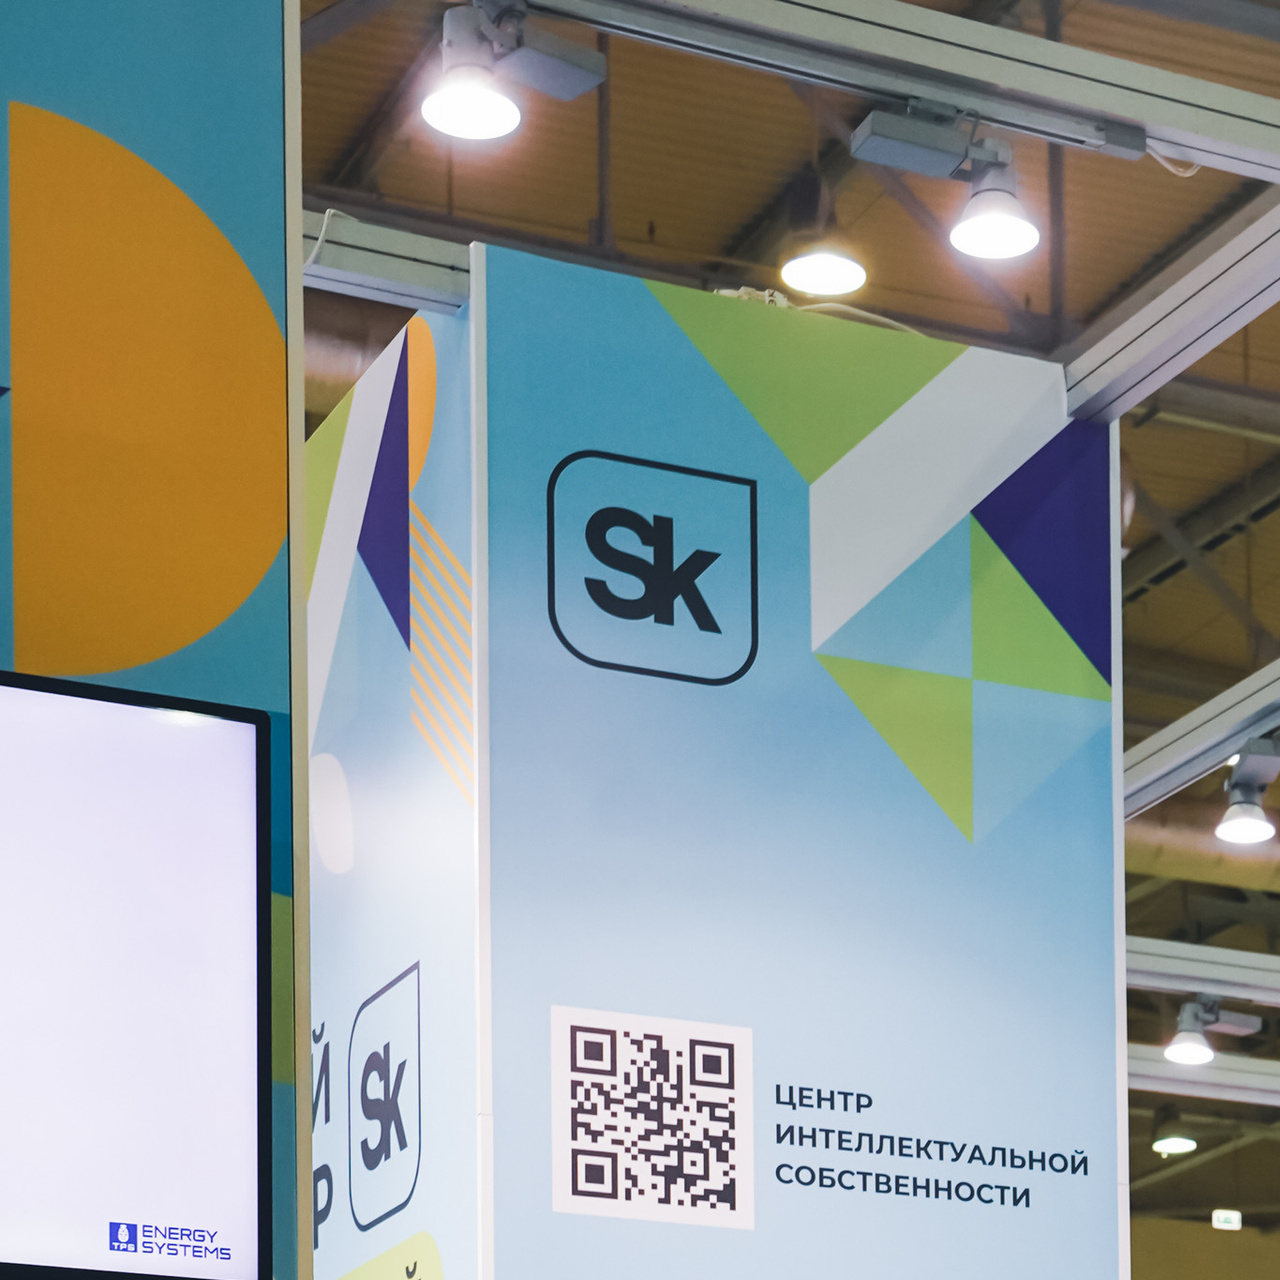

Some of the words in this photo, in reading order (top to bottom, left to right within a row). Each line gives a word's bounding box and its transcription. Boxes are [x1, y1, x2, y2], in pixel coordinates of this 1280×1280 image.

[584, 506, 722, 635] Sk
[361, 1041, 408, 1171] Sk
[775, 1083, 874, 1114] ЦЕНТР
[775, 1123, 1089, 1177] ИНТЕЛЛЕКТУАЛЬНОЙ
[774, 1163, 1031, 1209] СОБСТВЕННОСТИ
[112, 1242, 135, 1252] TPS
[142, 1224, 218, 1243] ENERGY
[142, 1241, 231, 1260] SYSTEMS
